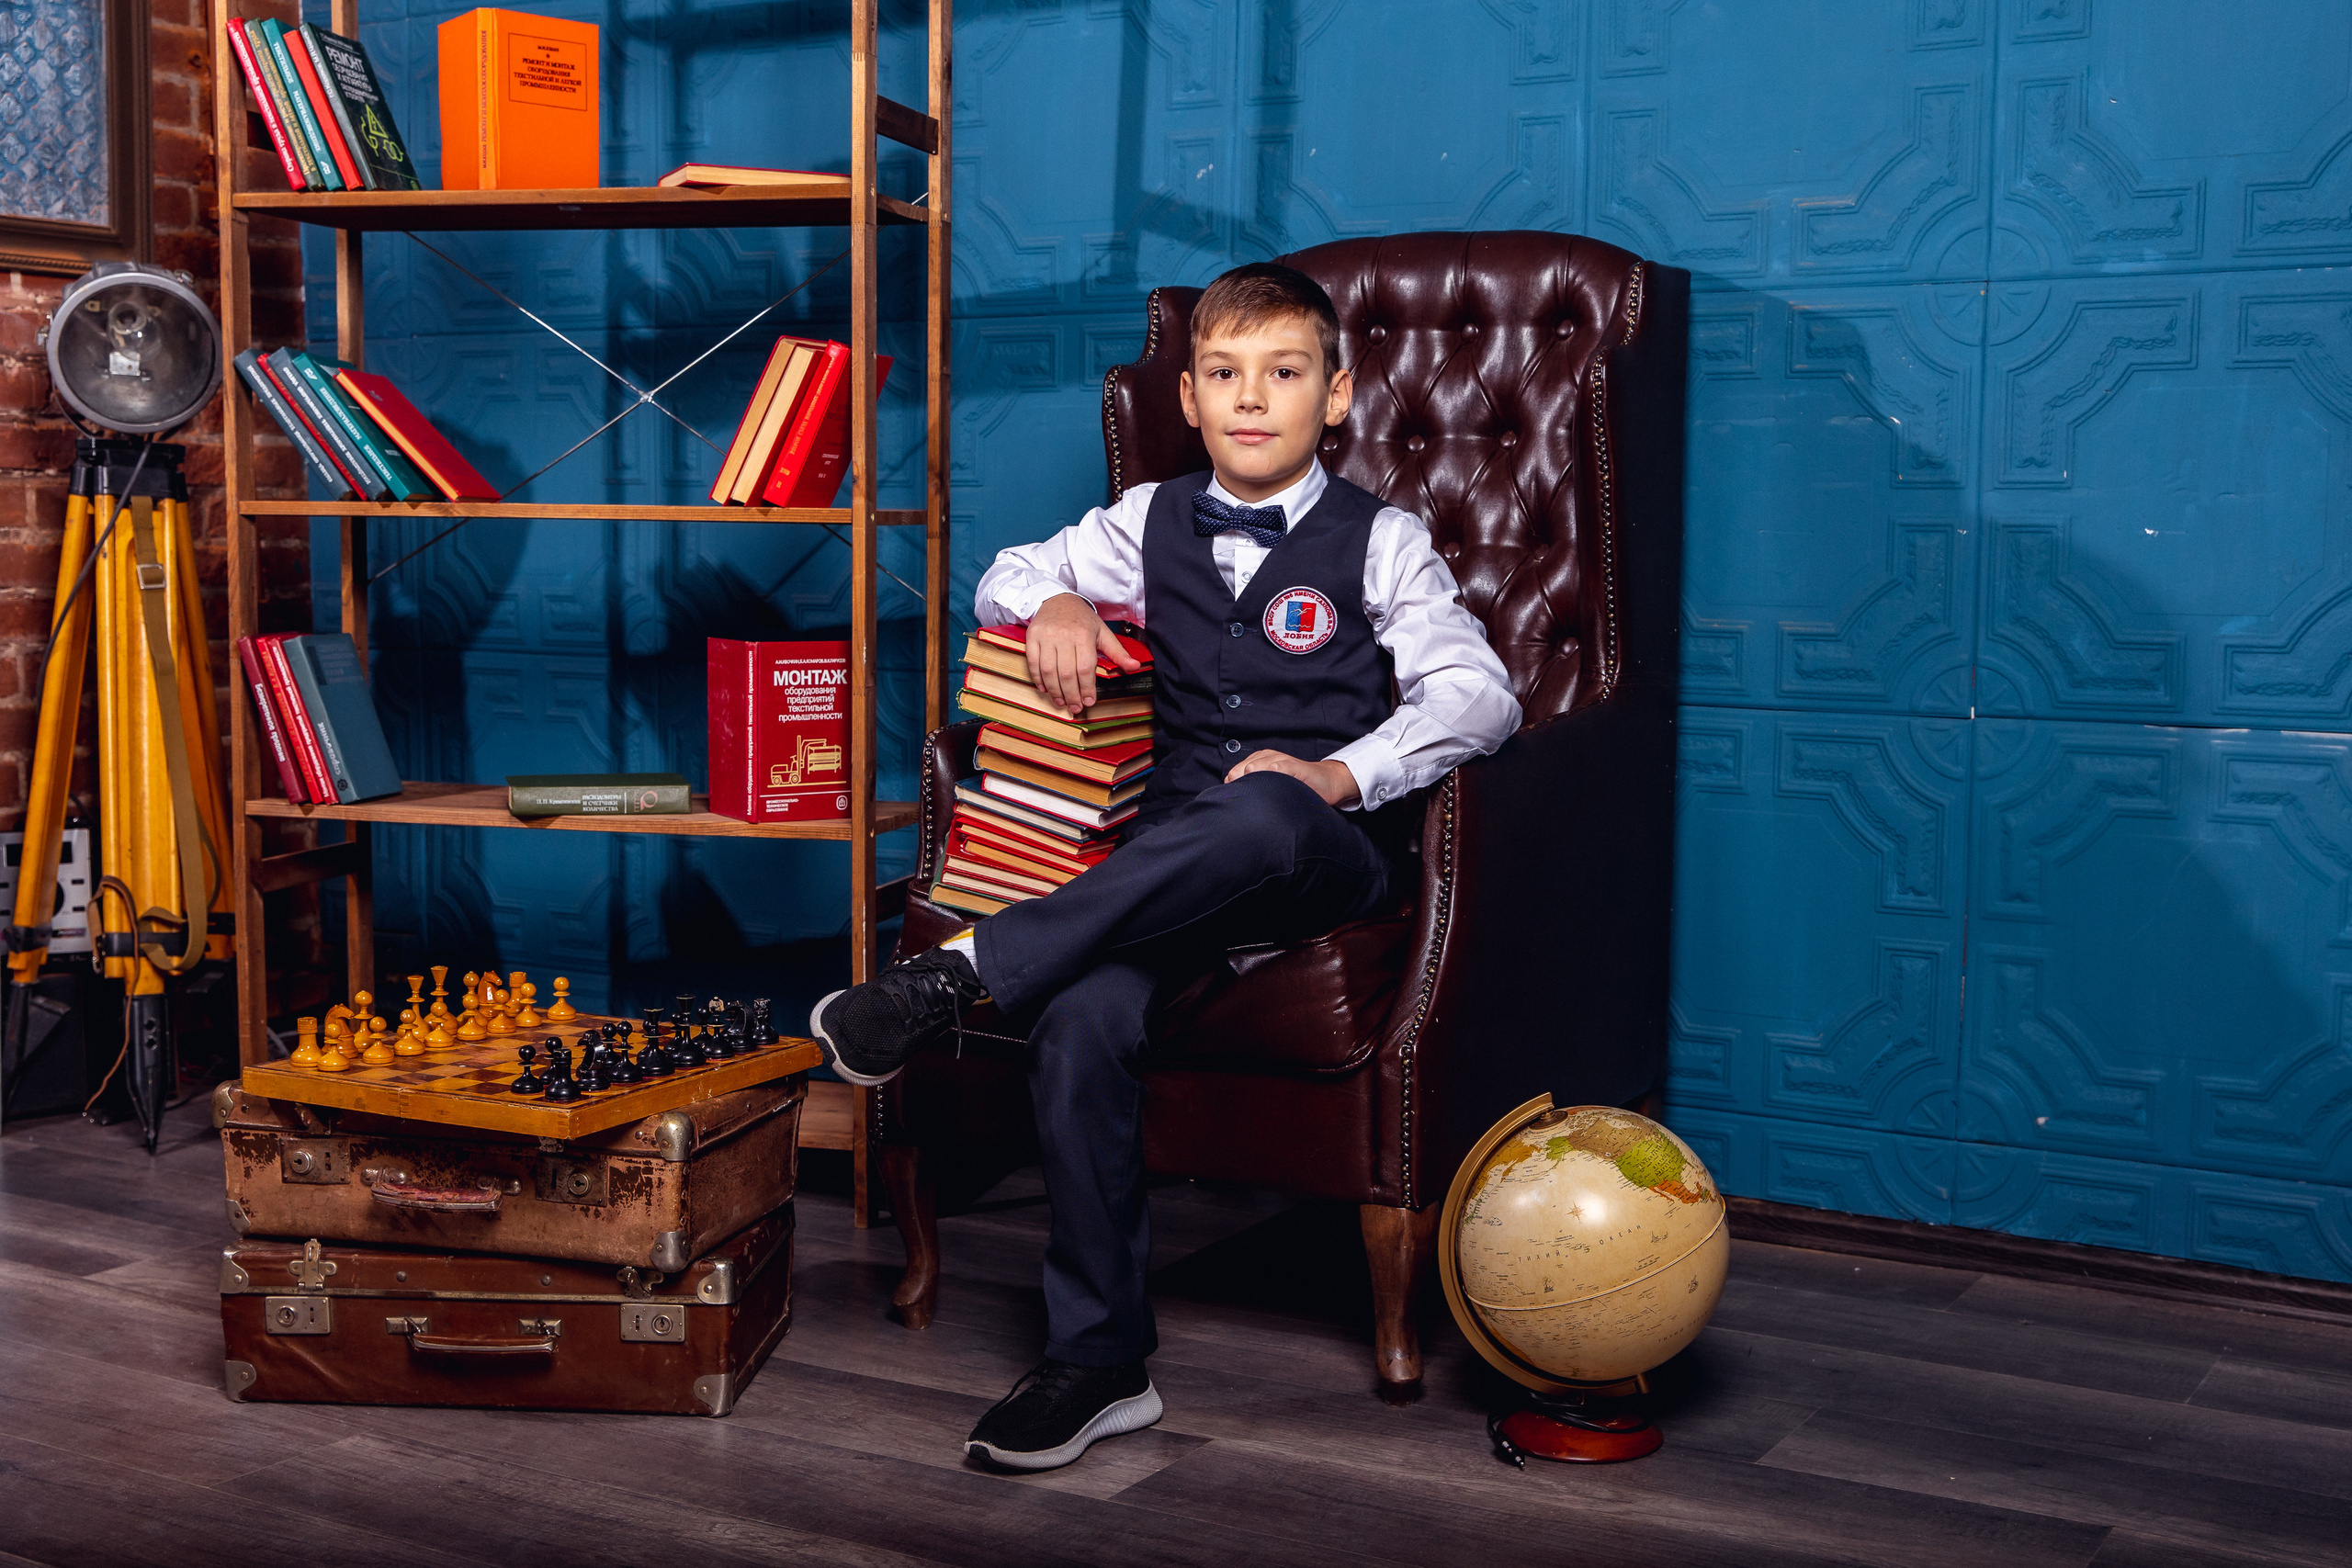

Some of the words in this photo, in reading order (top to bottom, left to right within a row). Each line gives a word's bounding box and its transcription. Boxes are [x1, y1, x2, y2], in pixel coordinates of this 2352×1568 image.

[325, 46, 365, 73] РЕМОНТ
[523, 58, 545, 66] РЕМОНТ
[551, 62, 575, 71] МОНТАЖ
[527, 66, 571, 77] ОБОРУДОВАНИЯ
[514, 72, 554, 83] ТЕКСТИЛЬНОЙ
[560, 77, 582, 86] ЛЕГКОЙ
[519, 80, 577, 94] ПРОМЫШЛЕННОСТИ
[1272, 599, 1284, 611] СОШ
[1271, 629, 1304, 650] МОСКОВСКАЯ
[1305, 632, 1329, 649] ОБЛАСТЬ
[774, 669, 848, 686] МОНТАЖ
[785, 686, 836, 696] оборудования
[787, 694, 834, 705] предприятий
[788, 703, 833, 713] текстильной
[254, 682, 274, 730] Безверетенное
[270, 731, 285, 761] прядение
[778, 713, 842, 723] промышленности
[317, 721, 341, 774] справочник
[1518, 1249, 1561, 1263] ТИХИЙ
[1599, 1224, 1642, 1246] ОКЕАН
